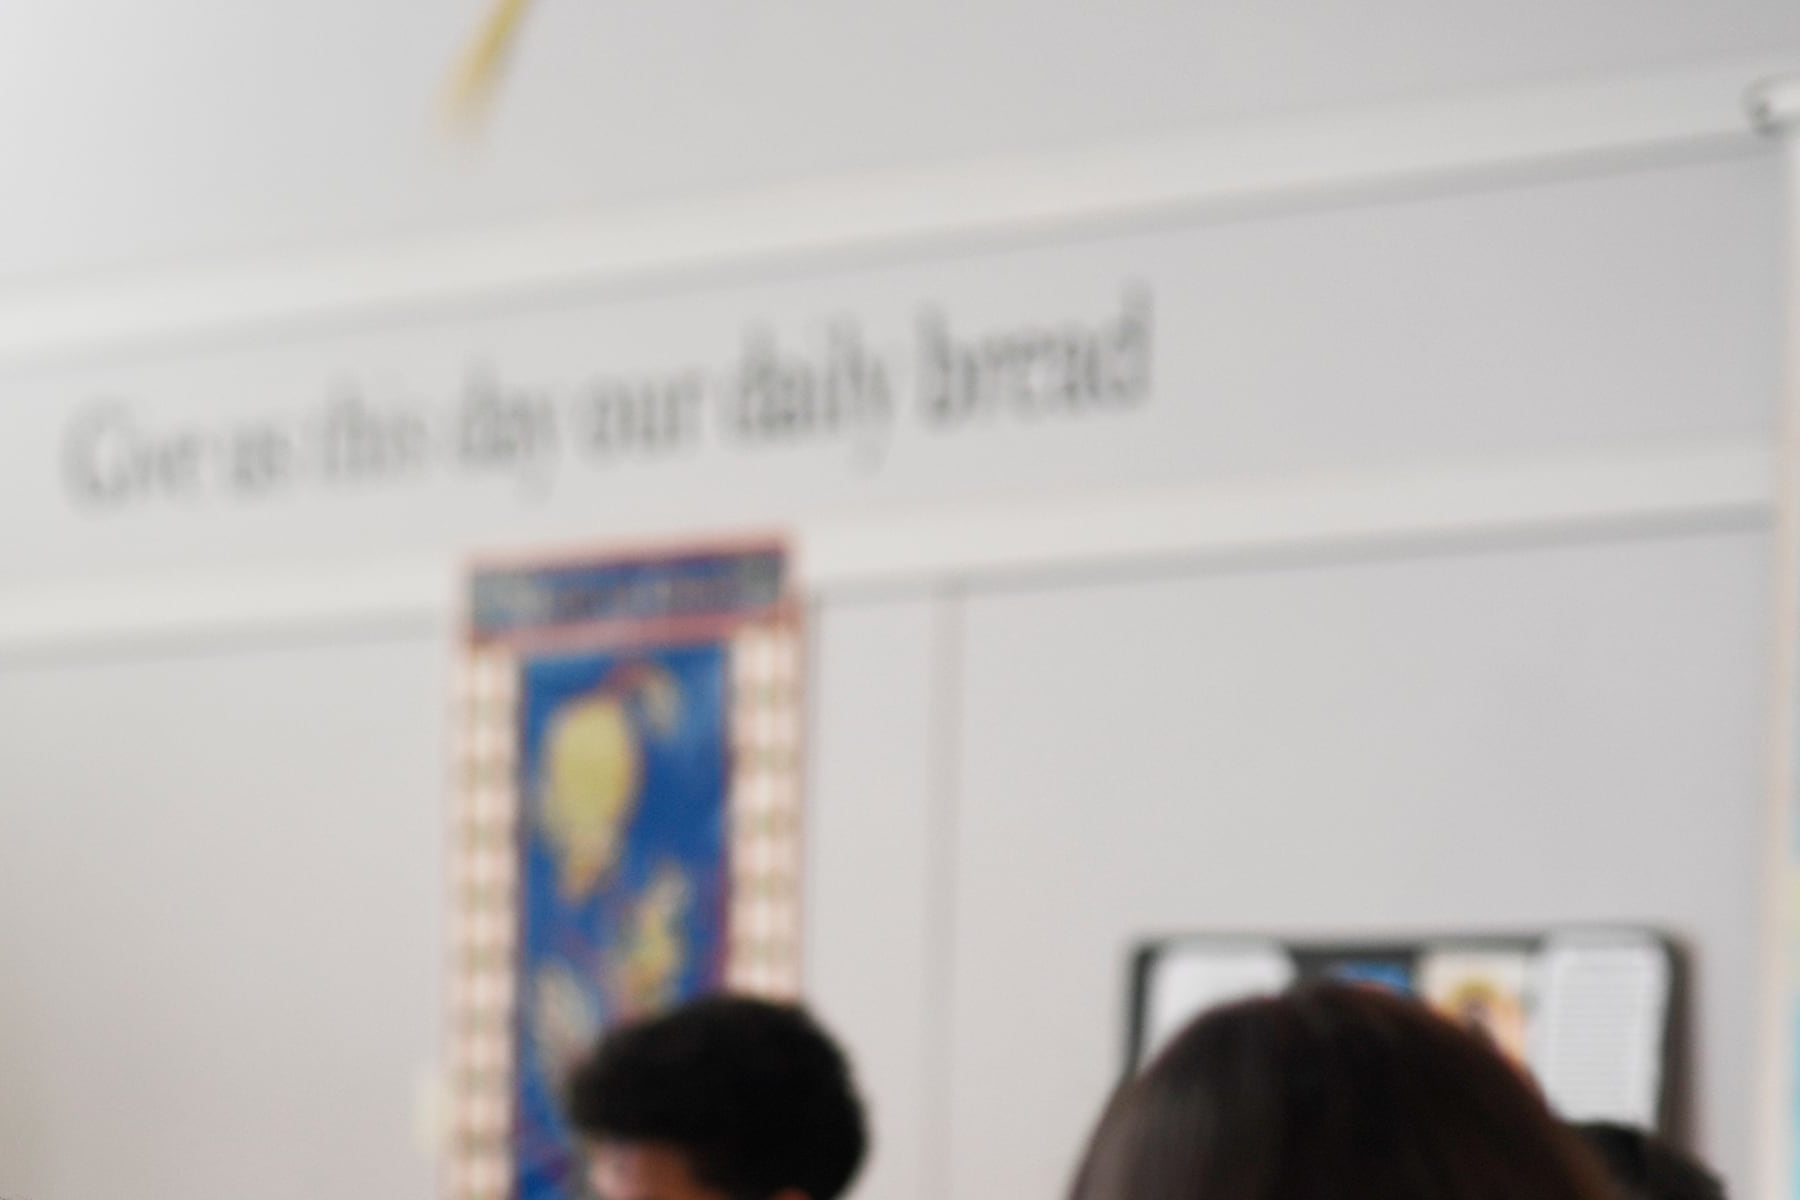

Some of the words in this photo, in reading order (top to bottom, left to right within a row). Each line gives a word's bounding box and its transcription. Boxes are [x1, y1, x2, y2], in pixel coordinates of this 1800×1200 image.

[63, 395, 204, 514] Give
[218, 420, 294, 501] us
[310, 372, 430, 490] this
[450, 364, 563, 508] day
[571, 368, 706, 470] our
[720, 313, 895, 476] daily
[915, 277, 1156, 431] bread
